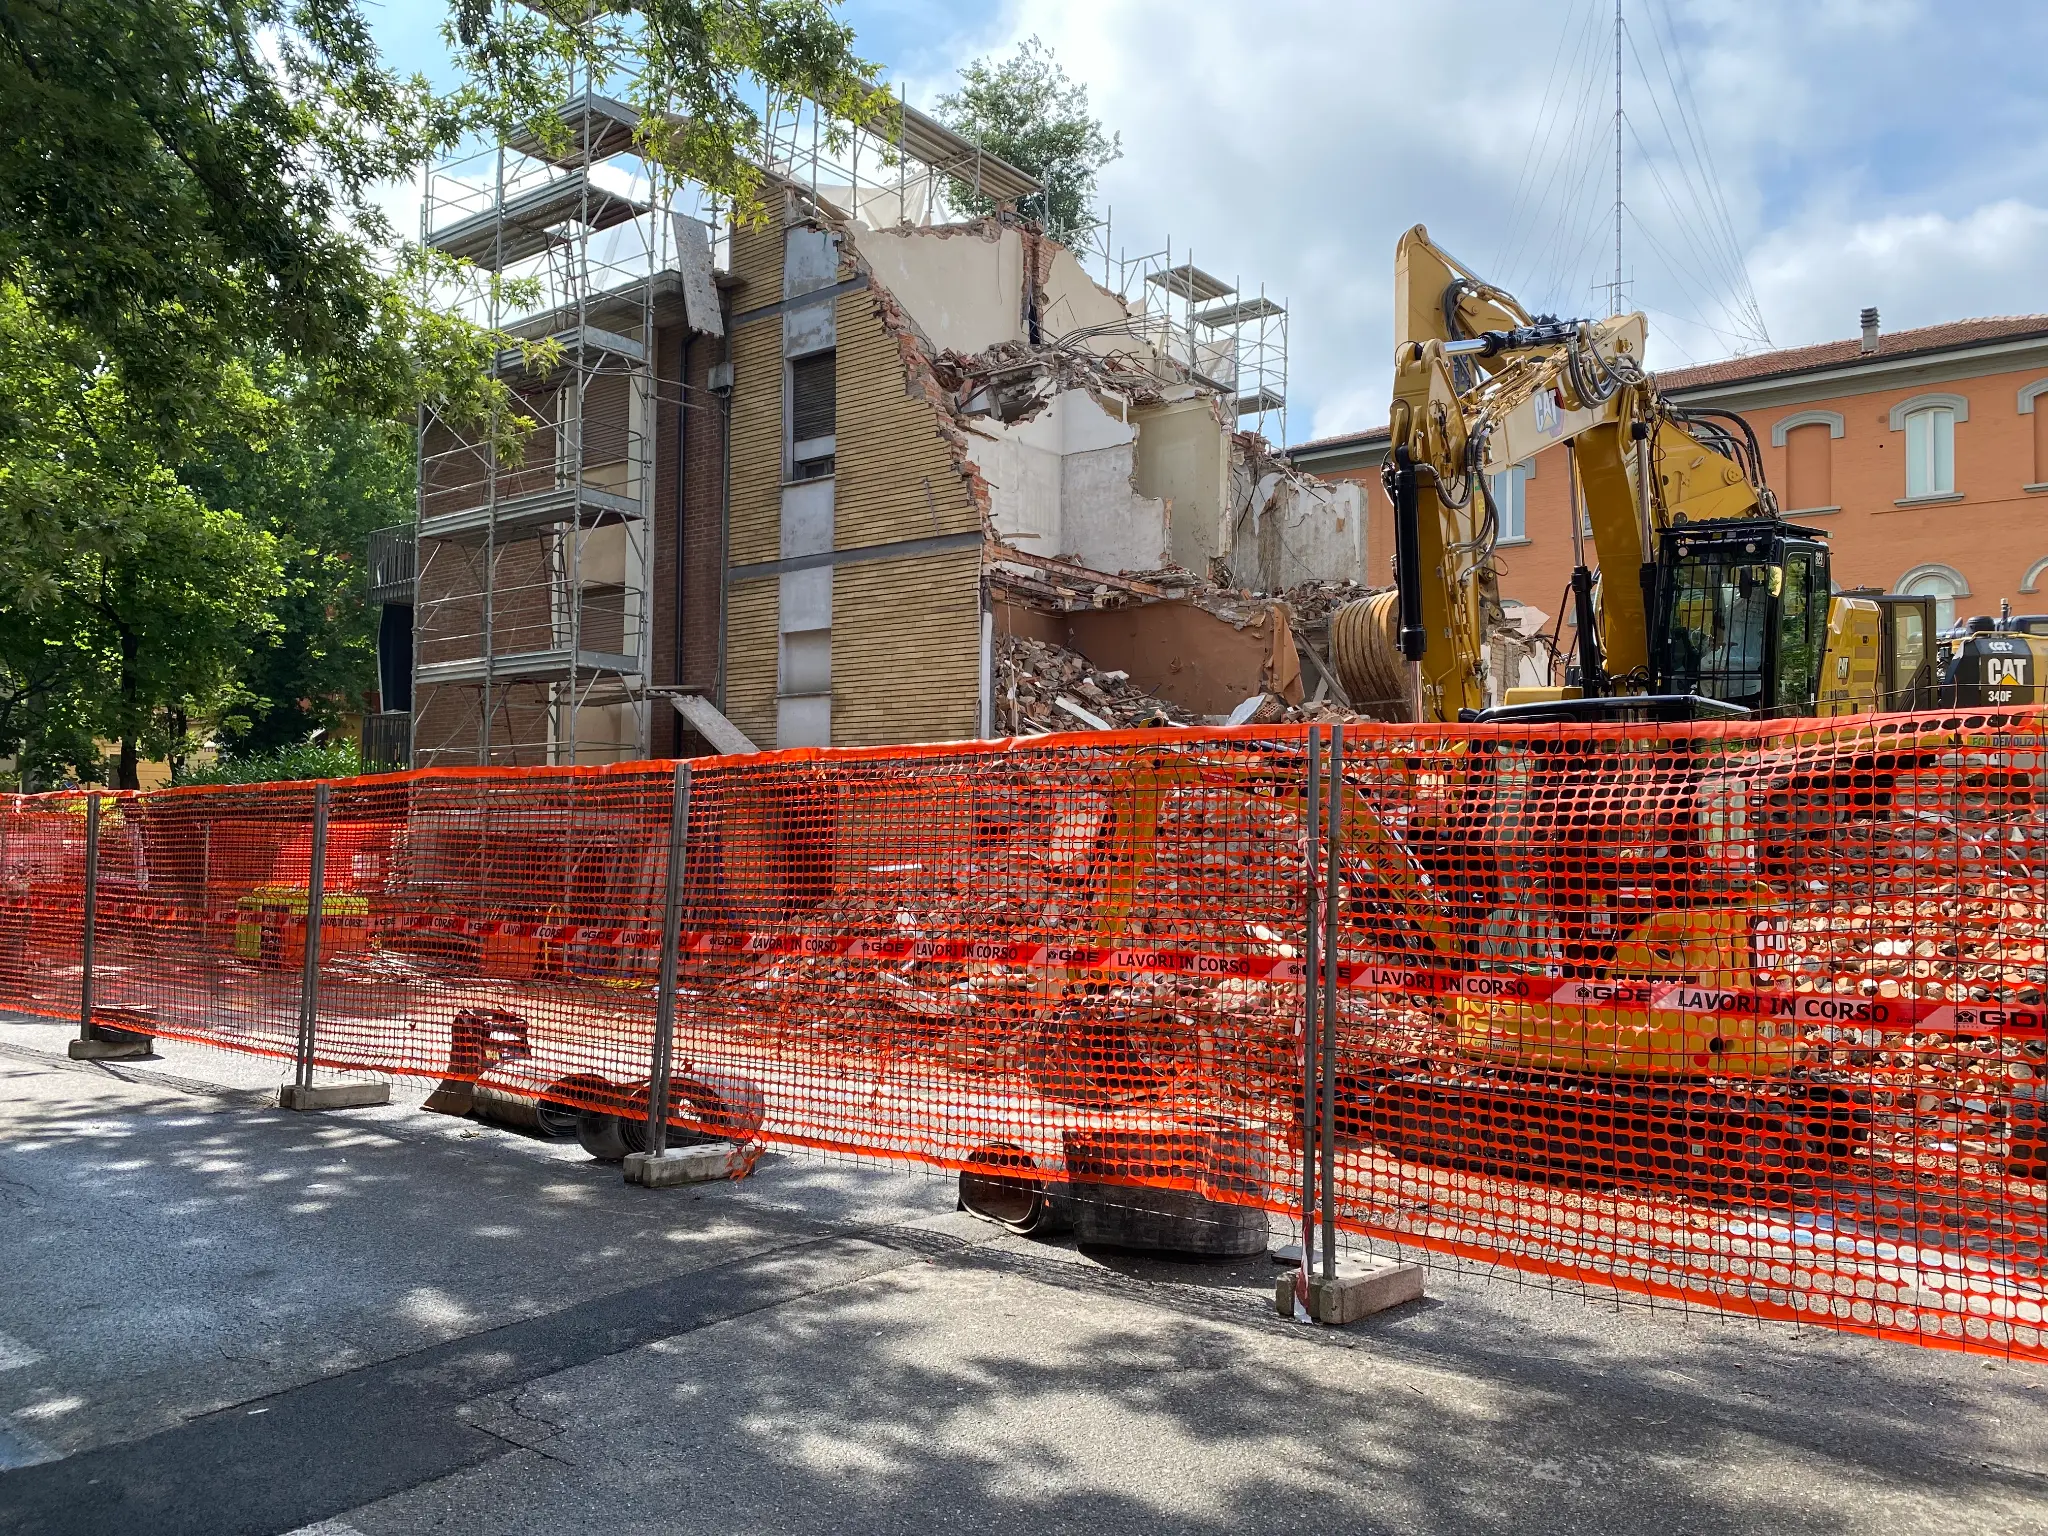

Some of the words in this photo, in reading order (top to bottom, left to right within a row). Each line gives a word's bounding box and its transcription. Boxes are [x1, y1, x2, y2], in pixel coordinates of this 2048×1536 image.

[1534, 389, 1558, 432] CAT
[1987, 658, 2027, 685] CAT
[1988, 690, 2012, 702] 340F
[434, 917, 458, 929] CORSO
[474, 922, 495, 931] GDE
[539, 927, 565, 938] CORSO
[588, 931, 612, 940] GDE
[622, 932, 649, 944] LAVORI
[752, 937, 787, 950] LAVORI
[790, 938, 801, 950] IN
[805, 939, 837, 952] CORSO
[871, 942, 905, 952] GDE
[916, 943, 957, 956] LAVORI
[961, 944, 974, 957] IN
[976, 945, 1018, 960] CORSO
[1059, 949, 1100, 962] GDE
[1118, 953, 1174, 968] LAVORI
[1179, 955, 1194, 970] IN
[1199, 957, 1250, 974] CORSO
[1371, 969, 1434, 989] LAVORI
[1441, 976, 1461, 992] IN
[1466, 978, 1530, 997] CORSO
[1593, 986, 1651, 1002] GDE
[1677, 990, 1762, 1014] LAVORI
[1769, 997, 1796, 1016] IN
[1804, 999, 1889, 1023] CORSO
[1979, 1010, 2048, 1030] GD
